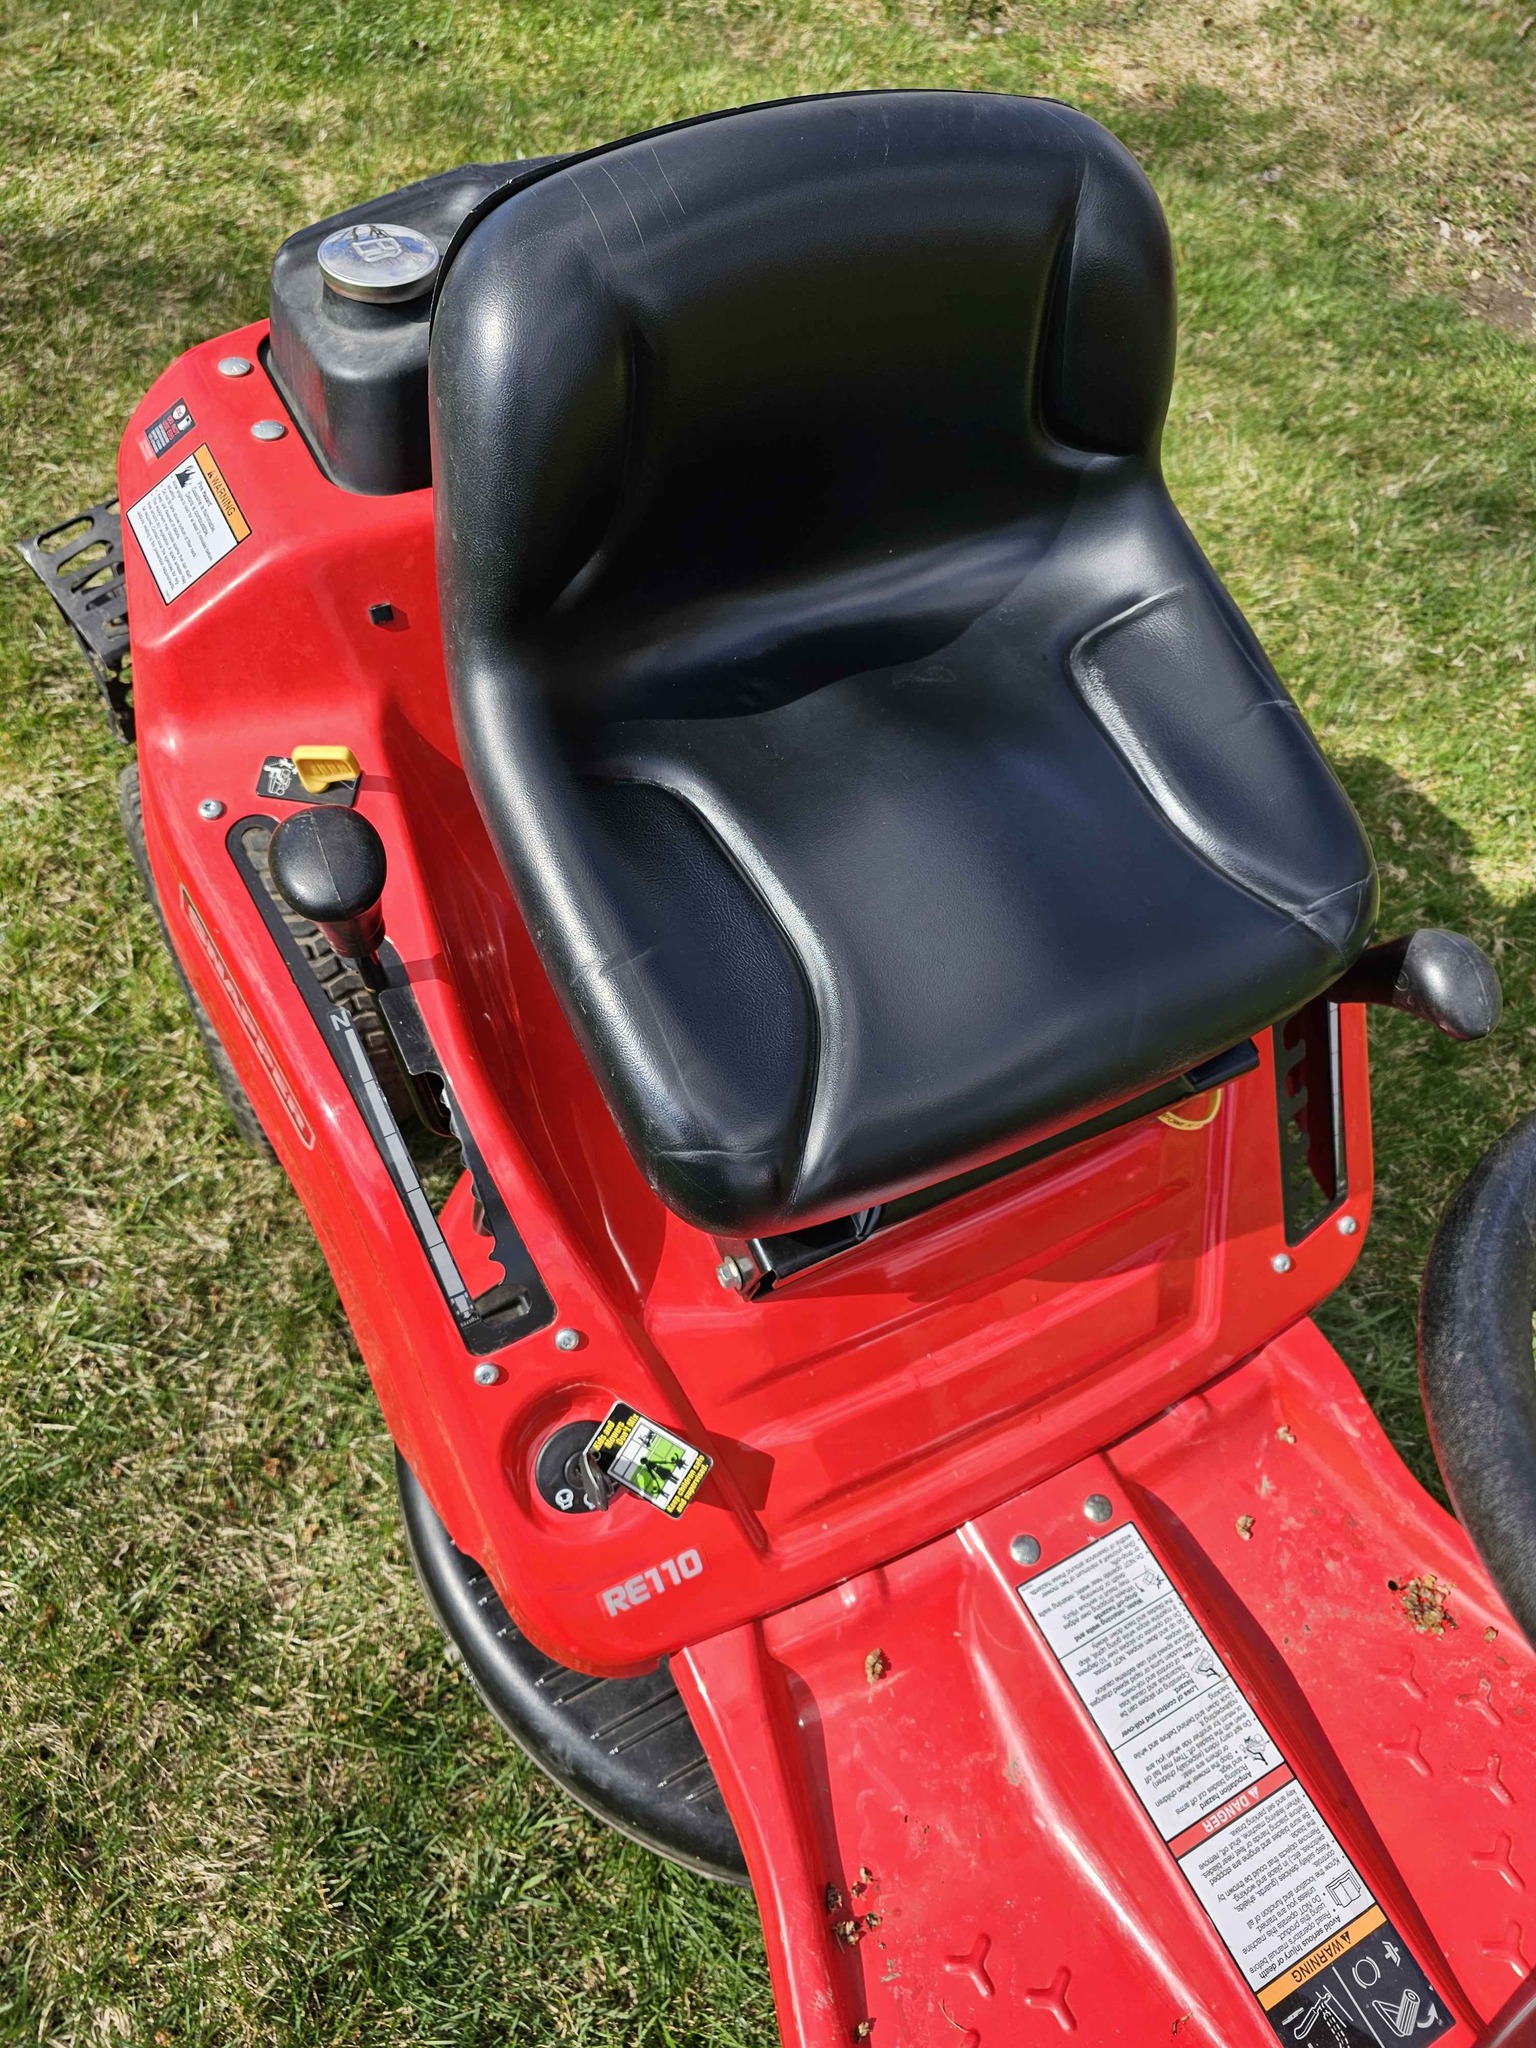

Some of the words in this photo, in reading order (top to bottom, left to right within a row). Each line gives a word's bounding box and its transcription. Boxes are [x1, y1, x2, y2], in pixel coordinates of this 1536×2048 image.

[209, 474, 237, 517] WARNING
[188, 903, 307, 1131] SNAPPER
[330, 1010, 352, 1032] N
[592, 1433, 607, 1452] Kids
[603, 1419, 615, 1437] and
[603, 1421, 625, 1450] Mowers
[615, 1425, 632, 1446] Don't
[626, 1413, 640, 1428] Mix
[666, 1495, 681, 1514] Keep
[677, 1469, 697, 1498] children
[693, 1454, 705, 1471] safe
[676, 1497, 688, 1514] and
[684, 1464, 709, 1500] supervised.
[602, 1548, 702, 1617] RE110
[1182, 1684, 1199, 1698] Loss
[1218, 1690, 1234, 1704] Look
[1155, 1697, 1178, 1715] control
[1204, 1699, 1221, 1713] down
[1175, 1715, 1196, 1732] behind
[1221, 1720, 1235, 1732] with
[1232, 1711, 1248, 1724] even
[1119, 1718, 1145, 1738] roll-over
[1157, 1727, 1177, 1743] before
[1191, 1724, 1213, 1742] another
[1218, 1729, 1234, 1743] carry
[1180, 1737, 1193, 1749] ride
[1194, 1733, 1215, 1750] blades
[1203, 1740, 1220, 1754] riders
[1131, 1745, 1149, 1760] while
[1165, 1744, 1182, 1759] when
[1170, 1749, 1188, 1765] They
[1204, 1748, 1223, 1764] others
[1218, 1751, 1233, 1765] Stop
[1174, 1749, 1205, 1773] (especially
[1150, 1768, 1162, 1778] fall
[1150, 1767, 1177, 1789] children)
[1191, 1766, 1211, 1783] mower
[1223, 1761, 1248, 1782] Rotating
[1175, 1779, 1193, 1793] when
[1205, 1777, 1226, 1794] blades
[1217, 1769, 1253, 1797] Amputation
[1154, 1789, 1178, 1808] children
[1198, 1792, 1220, 1810] hazard
[1283, 1795, 1302, 1811] When
[1174, 1801, 1190, 1815] arms
[1200, 1793, 1251, 1834] DANGER
[1244, 1806, 1268, 1827] parking
[1263, 1805, 1286, 1824] leaving
[1288, 1803, 1306, 1819] before
[1267, 1813, 1289, 1832] placing
[1288, 1816, 1302, 1829] sure
[1251, 1828, 1270, 1844] hands
[1270, 1825, 1290, 1842] blades
[1296, 1826, 1321, 1846] Remove
[1227, 1836, 1242, 1850] shut
[1233, 1844, 1246, 1857] feet
[1276, 1840, 1299, 1860] objects
[1313, 1840, 1331, 1856] Keep
[1197, 1851, 1220, 1870] remove
[1220, 1852, 1235, 1865] near
[1240, 1844, 1261, 1863] engine
[1266, 1855, 1279, 1867] that
[1286, 1849, 1302, 1864] etc.)
[1297, 1850, 1316, 1868] safety
[1250, 1862, 1268, 1878] could
[1265, 1862, 1283, 1879] place
[1277, 1862, 1300, 1882] devices
[1323, 1857, 1340, 1872] Know
[1207, 1864, 1232, 1885] stopped
[1223, 1879, 1245, 1897] thrown
[1292, 1874, 1316, 1894] location
[1296, 1885, 1317, 1903] unless
[1259, 1897, 1284, 1918] function
[1308, 1900, 1327, 1918] using
[1275, 1908, 1299, 1930] operate
[1298, 1912, 1312, 1925] this
[1314, 1910, 1331, 1926] Read
[1322, 1914, 1342, 1932] Avoid
[1264, 1925, 1278, 1938] this
[1286, 1920, 1316, 1946] operator's
[1300, 1927, 1324, 1948] serious
[1240, 1932, 1267, 1955] machine
[1266, 1941, 1289, 1961] manual
[1282, 1942, 1302, 1961] injury
[1248, 1956, 1269, 1975] before
[1289, 1936, 1345, 1984] WARNING
[1258, 1961, 1277, 1979] death
